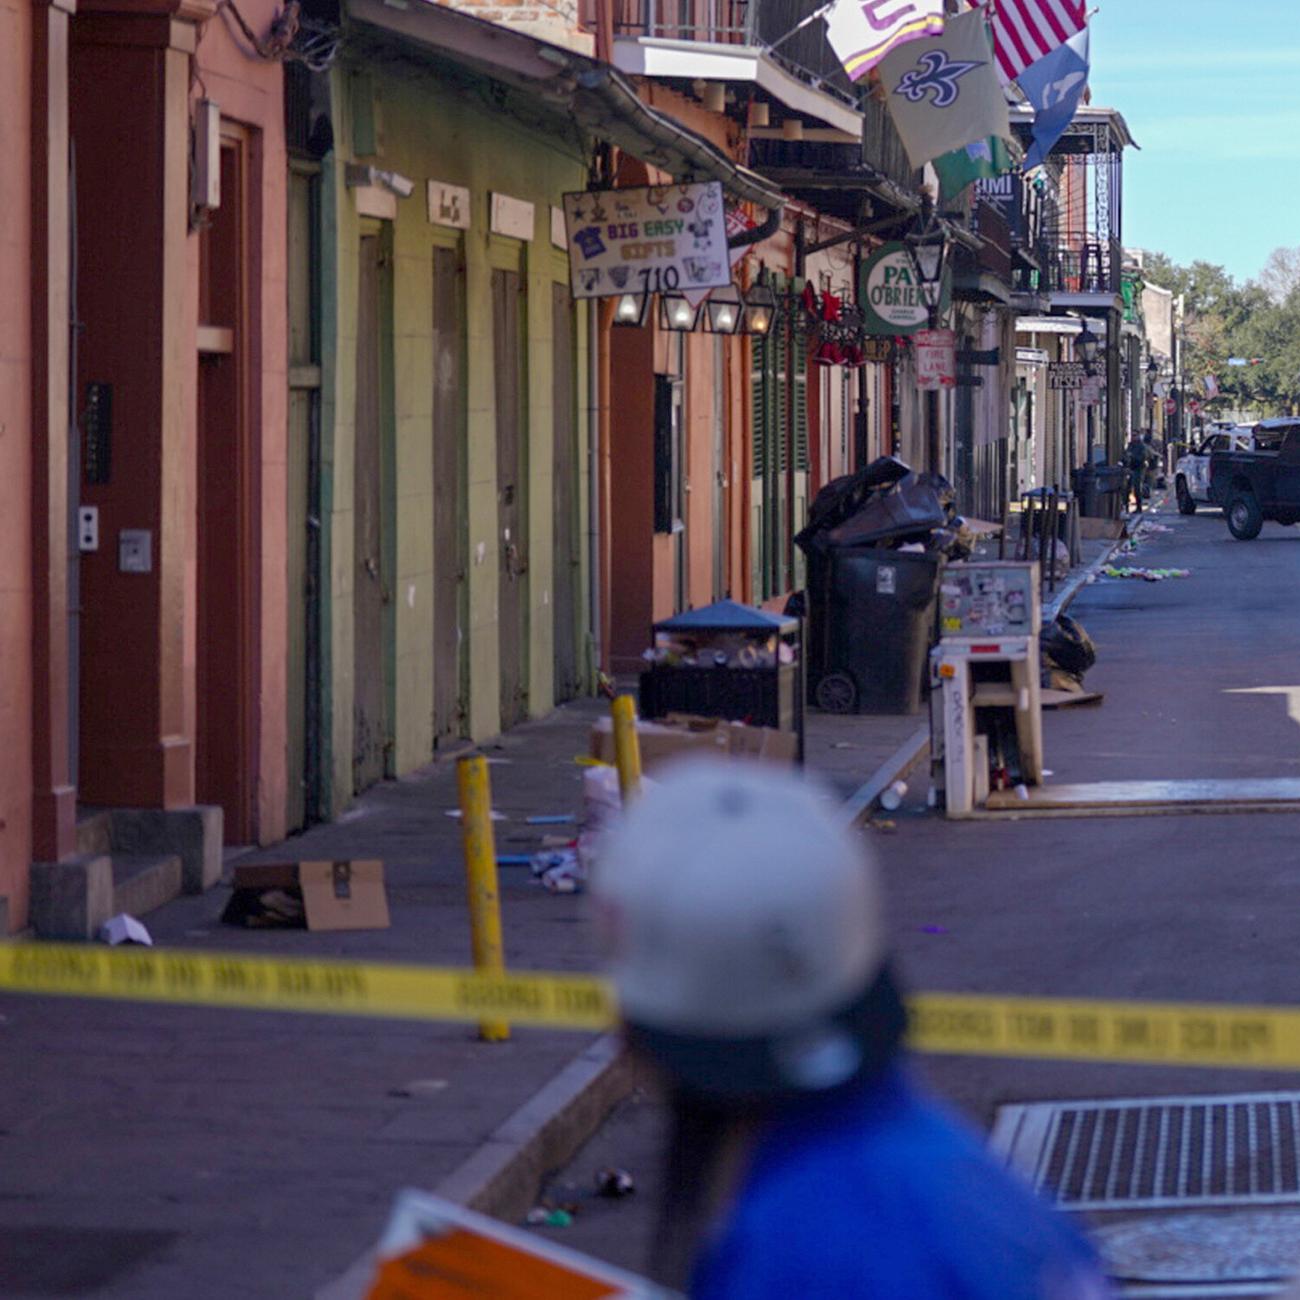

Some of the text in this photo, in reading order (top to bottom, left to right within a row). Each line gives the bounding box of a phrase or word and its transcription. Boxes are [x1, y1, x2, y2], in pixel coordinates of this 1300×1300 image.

[607, 219, 685, 240] BIG EASY
[621, 240, 676, 261] GIFTS
[638, 265, 680, 293] 710
[925, 350, 945, 360] FIRE
[924, 361, 947, 372] LANE
